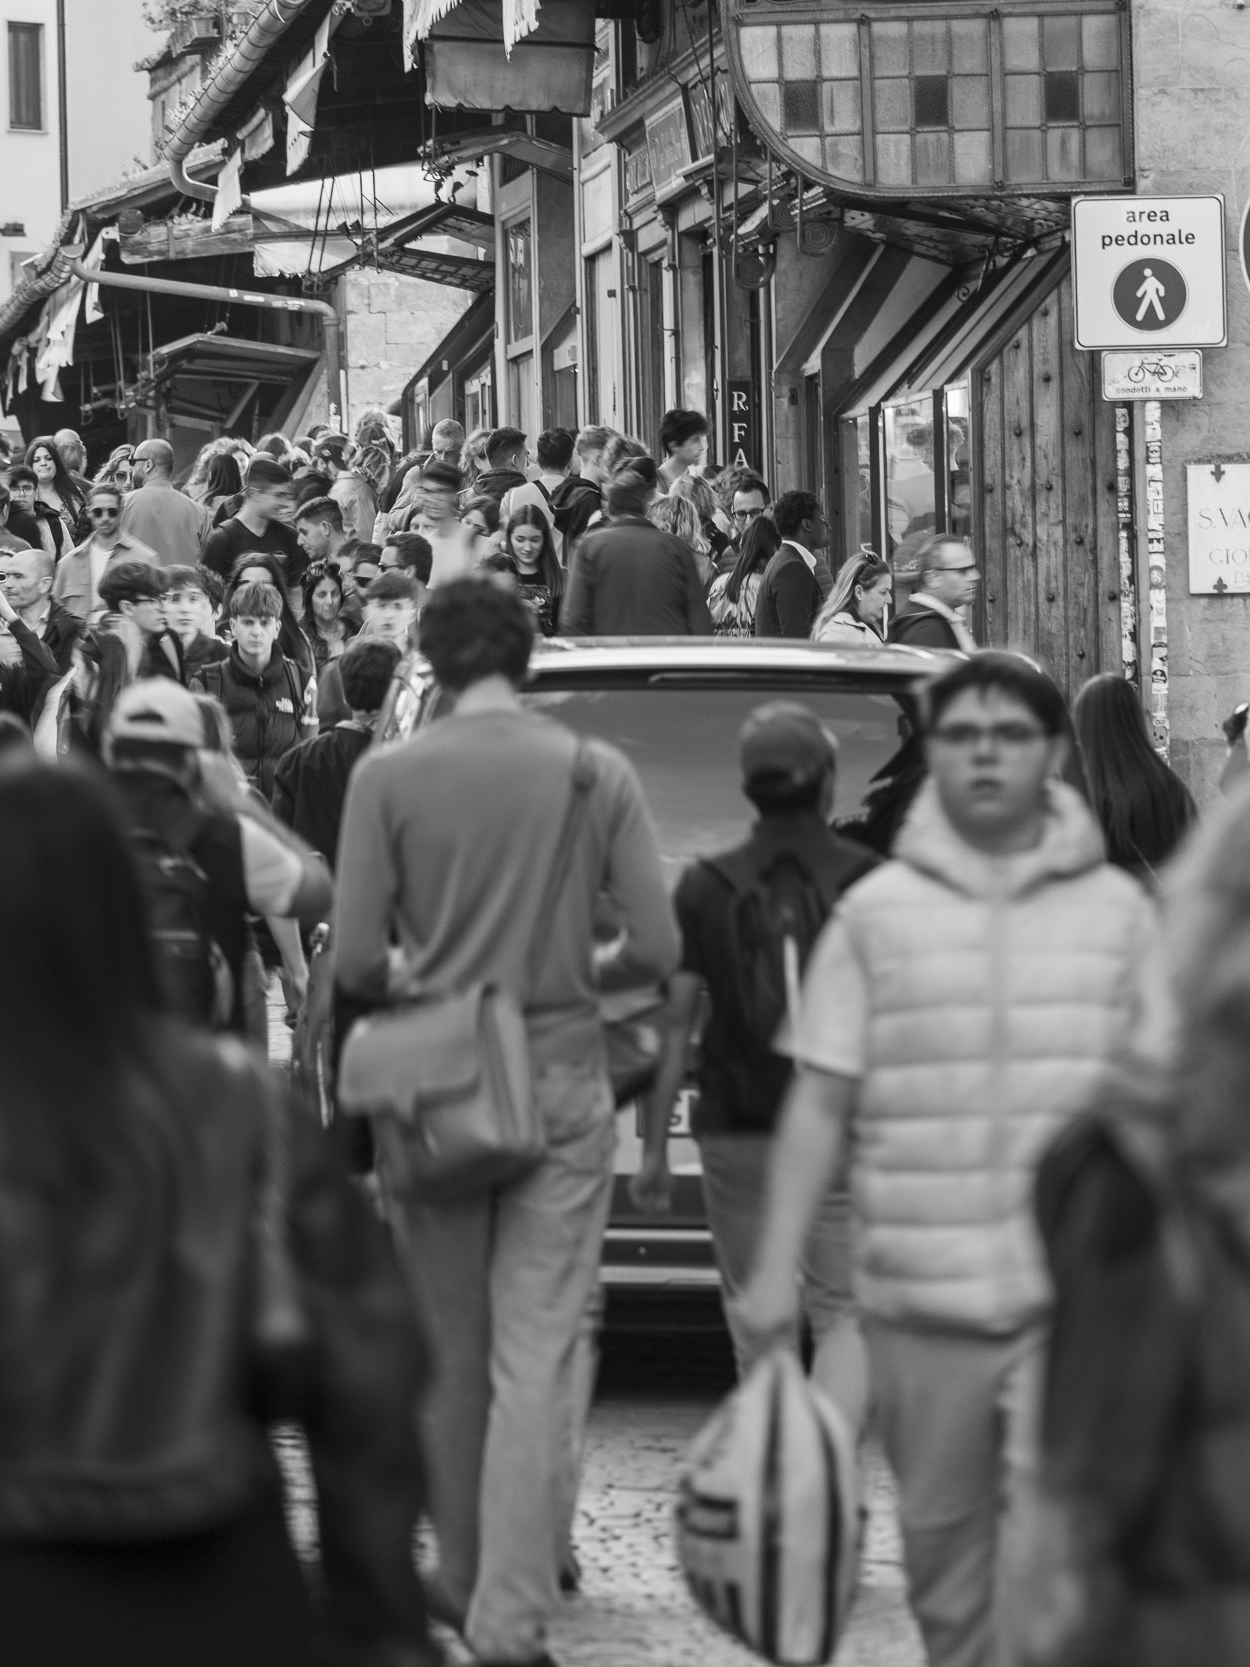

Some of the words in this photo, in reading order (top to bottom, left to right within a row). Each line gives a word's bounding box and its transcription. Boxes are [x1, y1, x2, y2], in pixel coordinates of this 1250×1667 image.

[1126, 209, 1170, 223] area
[1101, 229, 1196, 250] pedonale
[1116, 386, 1151, 394] condotti
[1209, 548, 1250, 566] GIO
